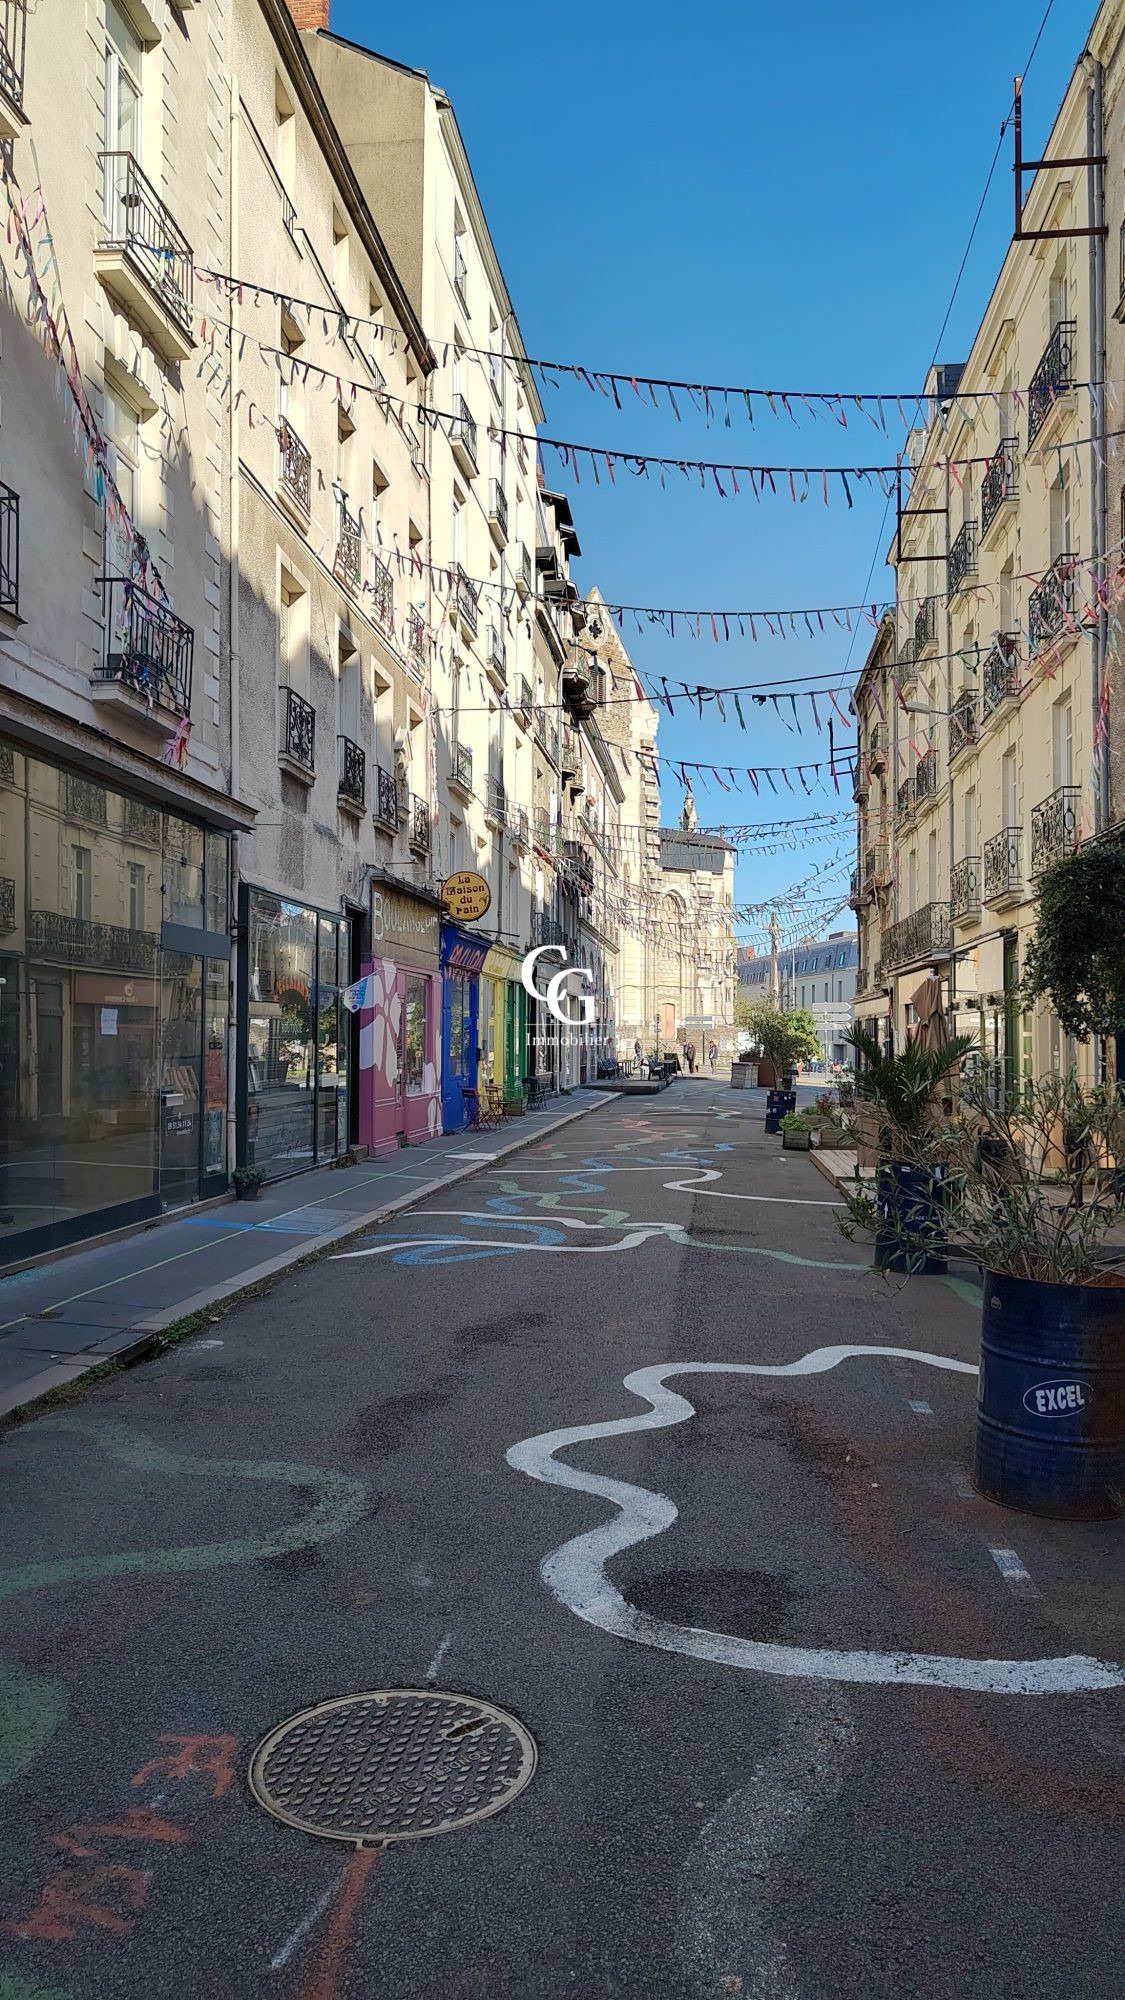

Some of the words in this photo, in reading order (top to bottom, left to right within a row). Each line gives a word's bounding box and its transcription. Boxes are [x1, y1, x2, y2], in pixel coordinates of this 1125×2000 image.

[457, 875, 471, 885] La
[446, 884, 485, 896] Maison
[460, 895, 473, 904] du
[456, 905, 480, 915] Pain
[1034, 1384, 1085, 1412] EXCEL
[421, 1750, 488, 1784] FONDERIE
